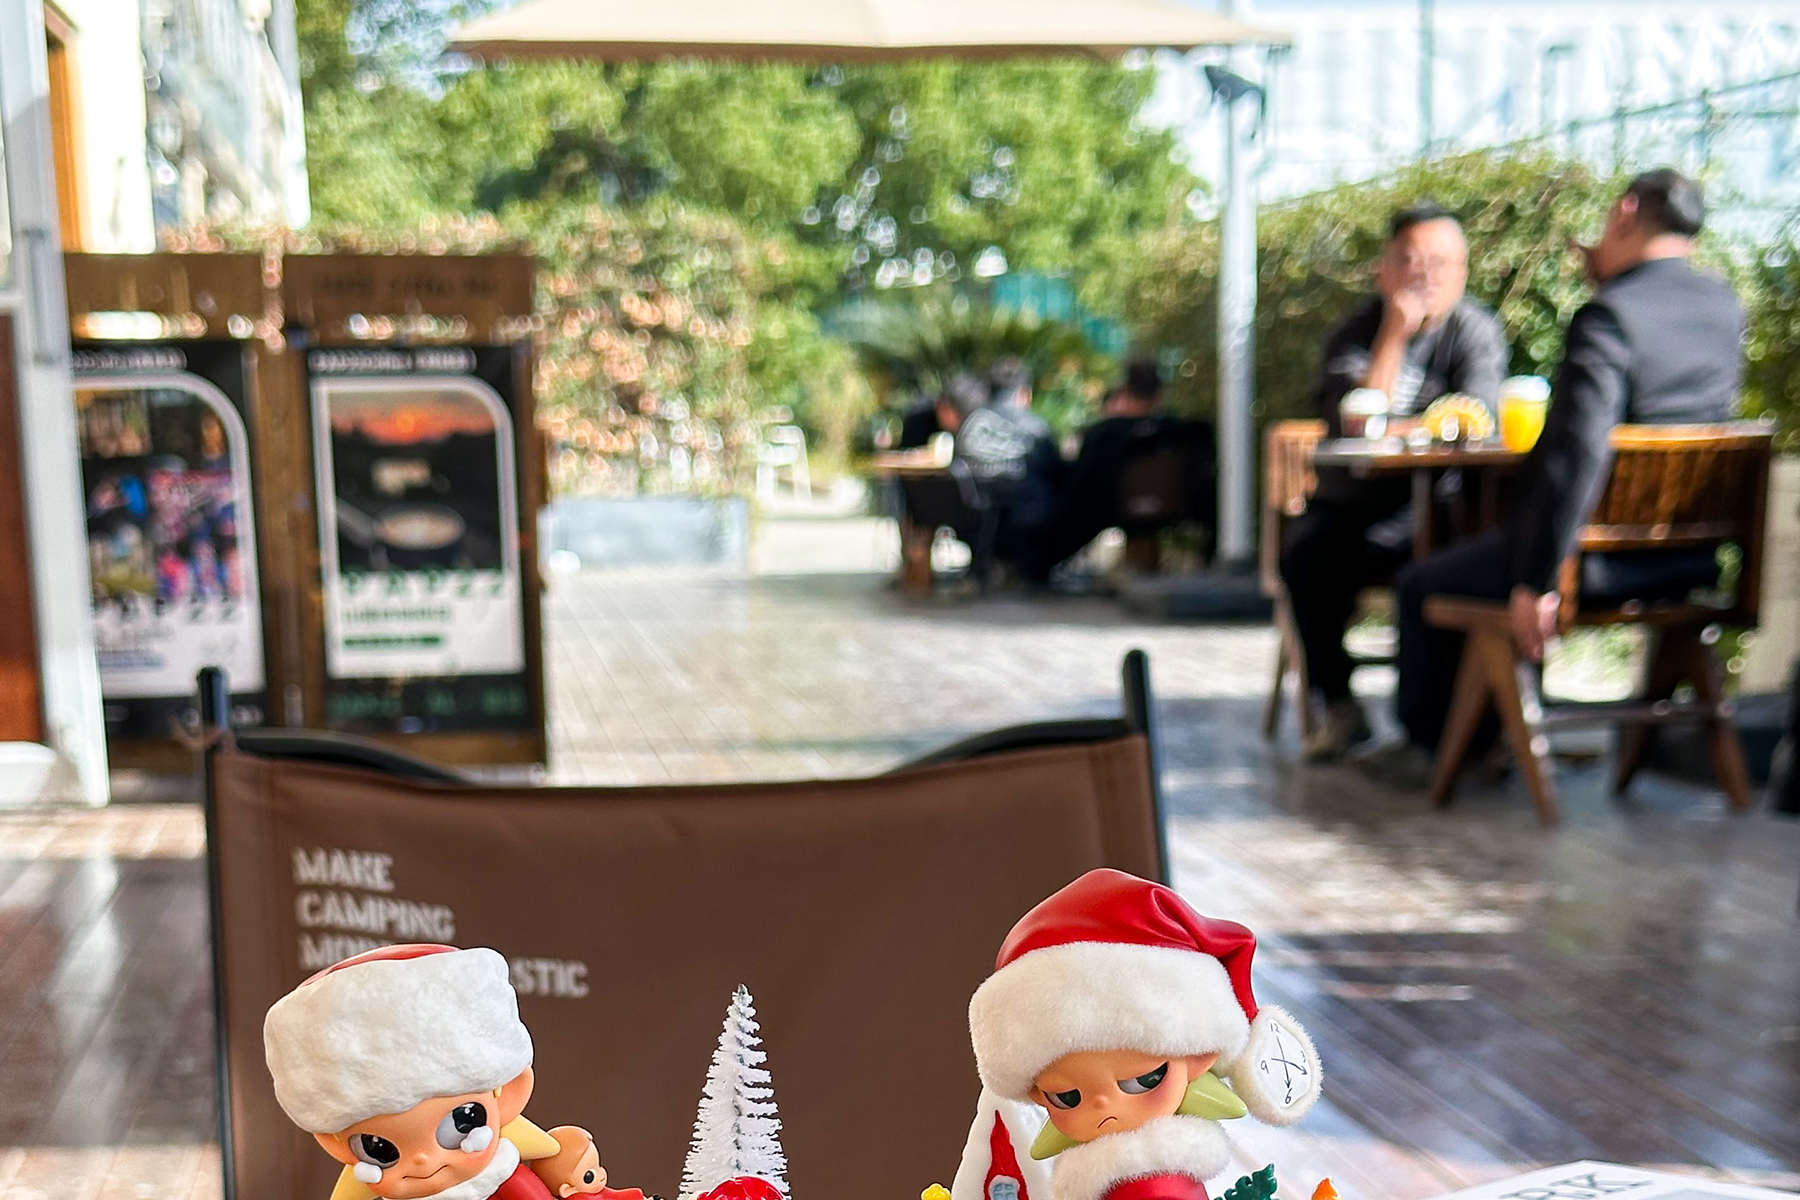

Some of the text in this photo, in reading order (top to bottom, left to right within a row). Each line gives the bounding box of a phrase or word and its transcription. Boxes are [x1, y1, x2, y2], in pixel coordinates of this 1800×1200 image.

[291, 847, 396, 892] MAKE
[296, 890, 456, 942] CAMPING
[509, 956, 589, 998] STIC
[1270, 1022, 1281, 1034] 12
[1260, 1059, 1269, 1075] 9
[1284, 1087, 1293, 1105] 6
